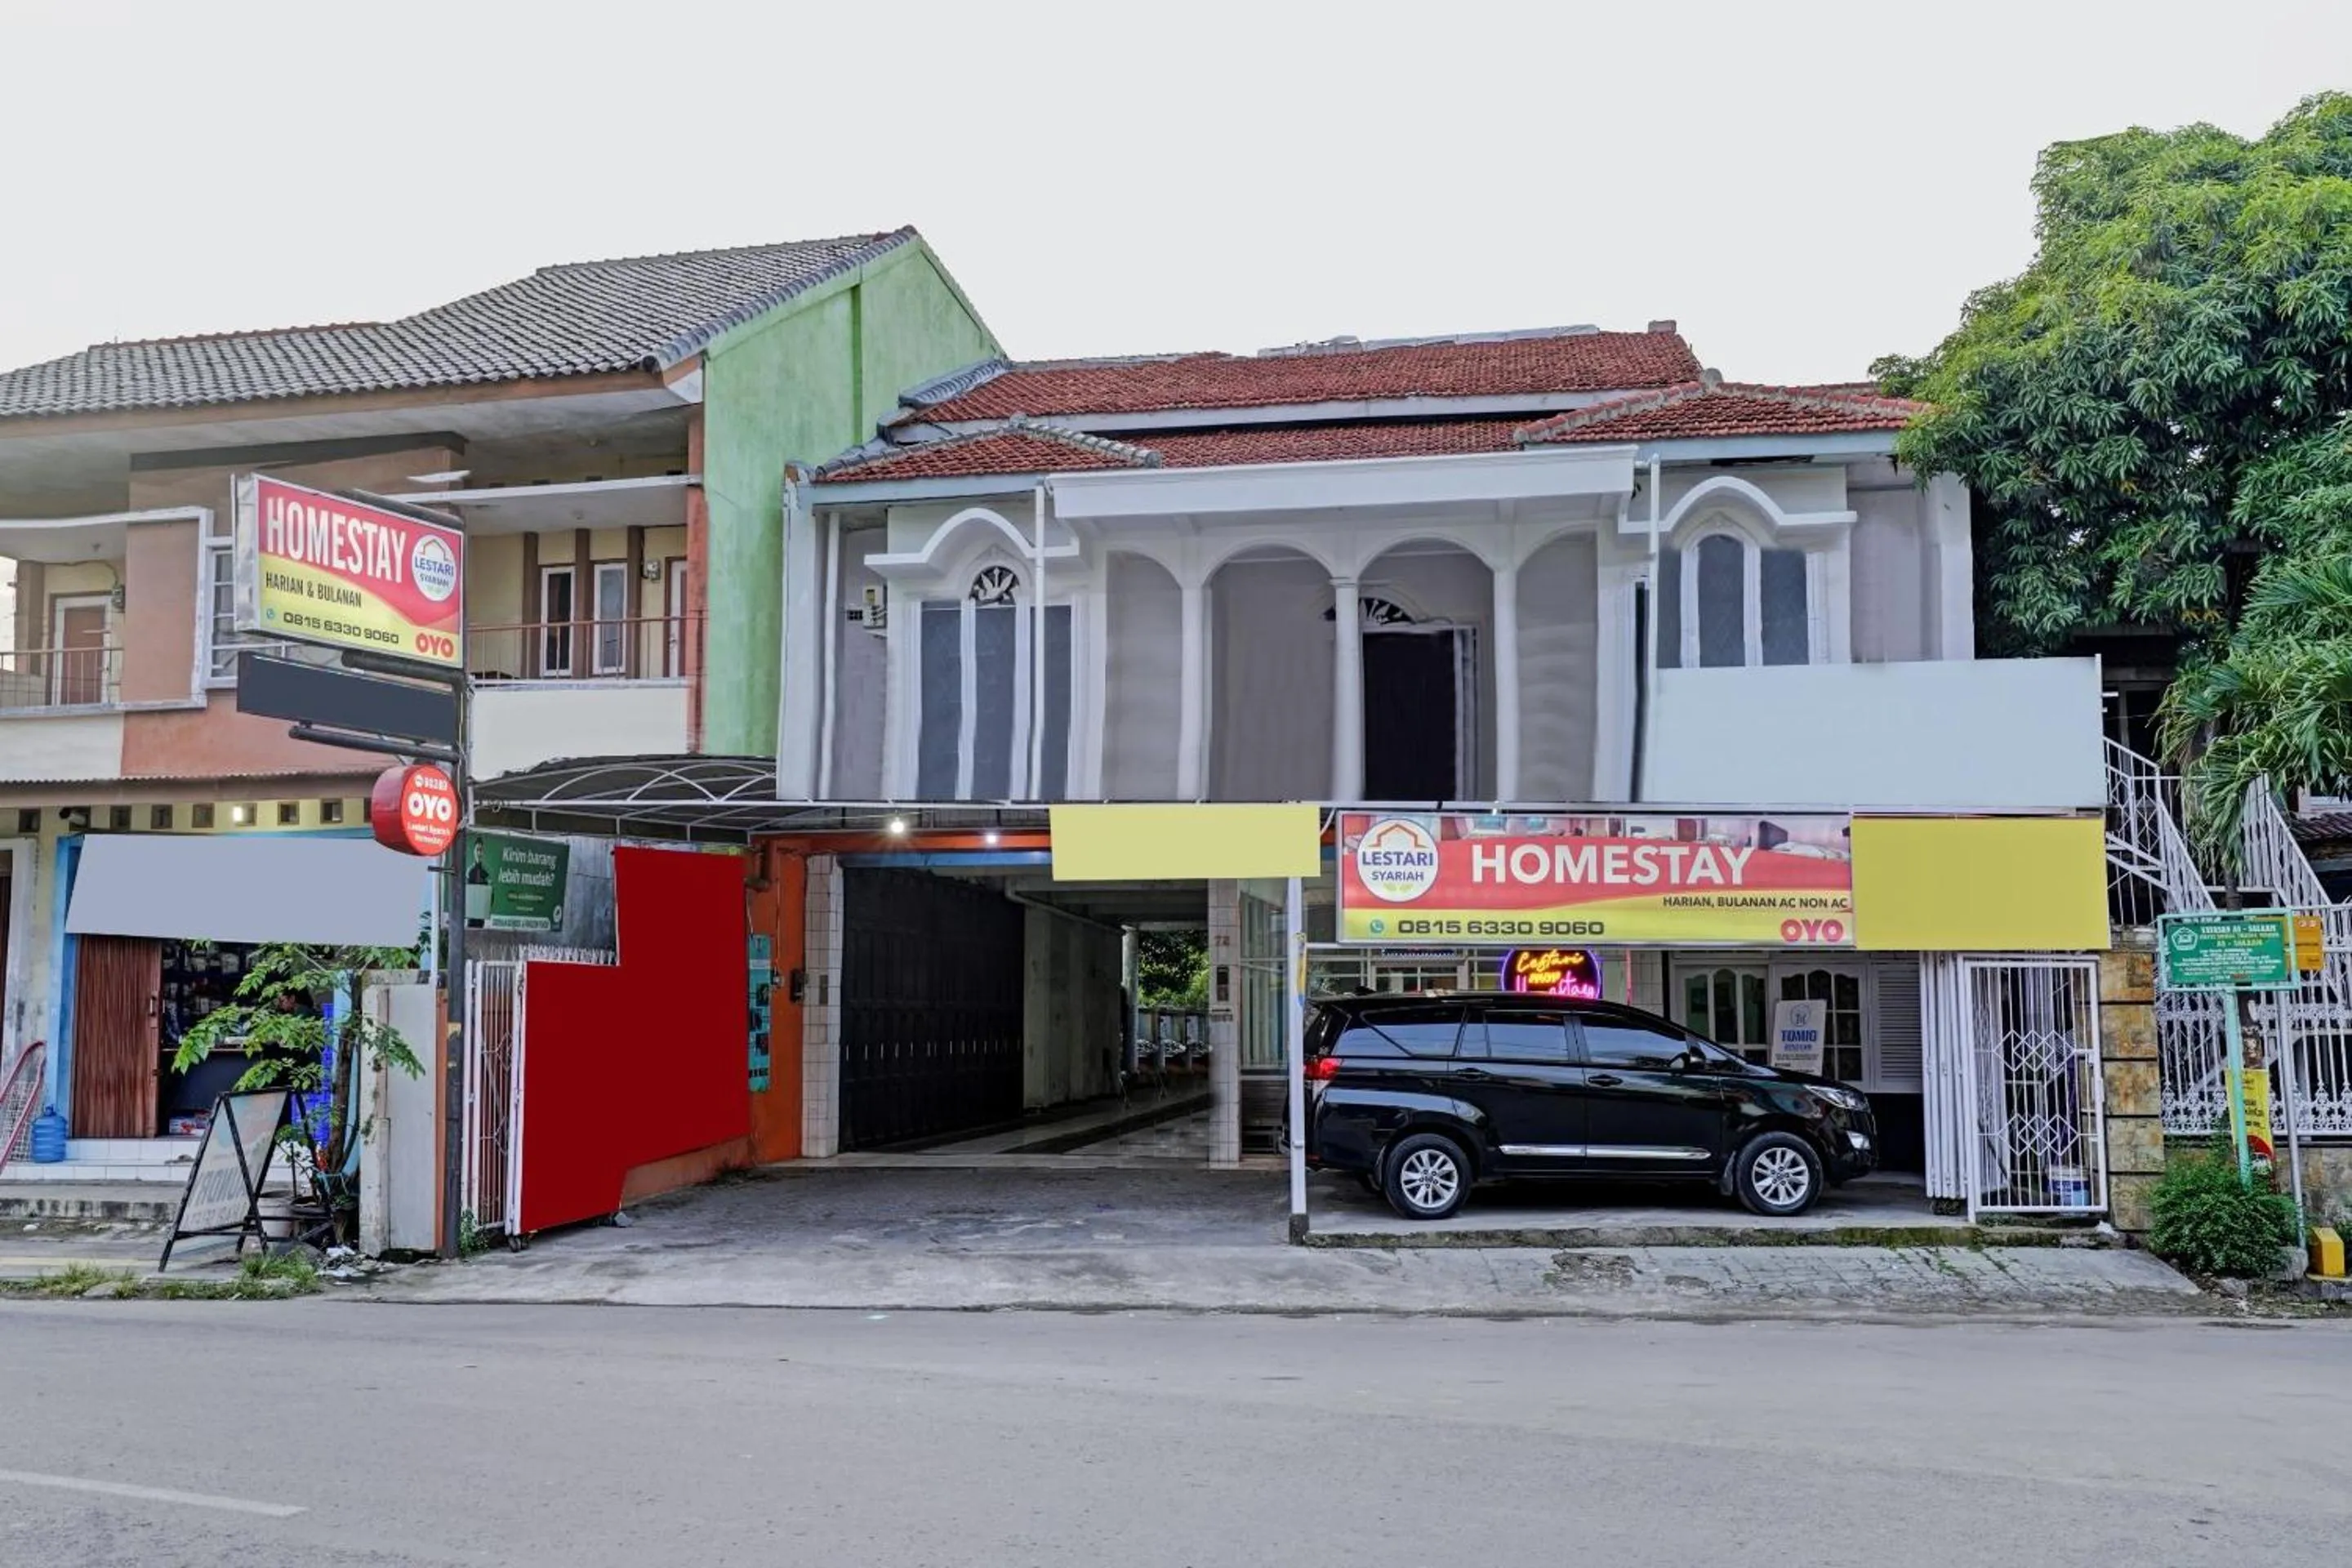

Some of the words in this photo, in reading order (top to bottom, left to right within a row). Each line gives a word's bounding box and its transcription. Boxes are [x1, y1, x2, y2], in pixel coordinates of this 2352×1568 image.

[266, 497, 407, 583] HOMESTAY
[415, 556, 454, 577] LESTARI
[266, 572, 303, 595] HARIAN
[307, 583, 314, 598] &
[318, 586, 362, 608] BULANAN
[283, 612, 321, 629] 0815
[324, 620, 361, 636] 6330
[364, 628, 399, 644] 9060
[416, 633, 454, 657] OYO
[408, 792, 452, 822] OYO
[502, 847, 526, 863] Kirim
[1362, 851, 1434, 866] LESTARI
[1472, 844, 1757, 885] HOMESTAY
[498, 867, 520, 884] lebih
[1371, 871, 1424, 881] SYARIAH
[1663, 896, 1714, 908] HARIAN,
[1717, 897, 1776, 907] BULANAN
[1779, 898, 1797, 908] AC
[1799, 898, 1828, 908] NON
[1831, 898, 1848, 908] AC
[1398, 920, 1461, 934] 0815
[1467, 920, 1533, 934] 6330
[1539, 920, 1605, 935] 9060
[1780, 918, 1844, 942] OYO
[1517, 949, 1584, 973] Lestari
